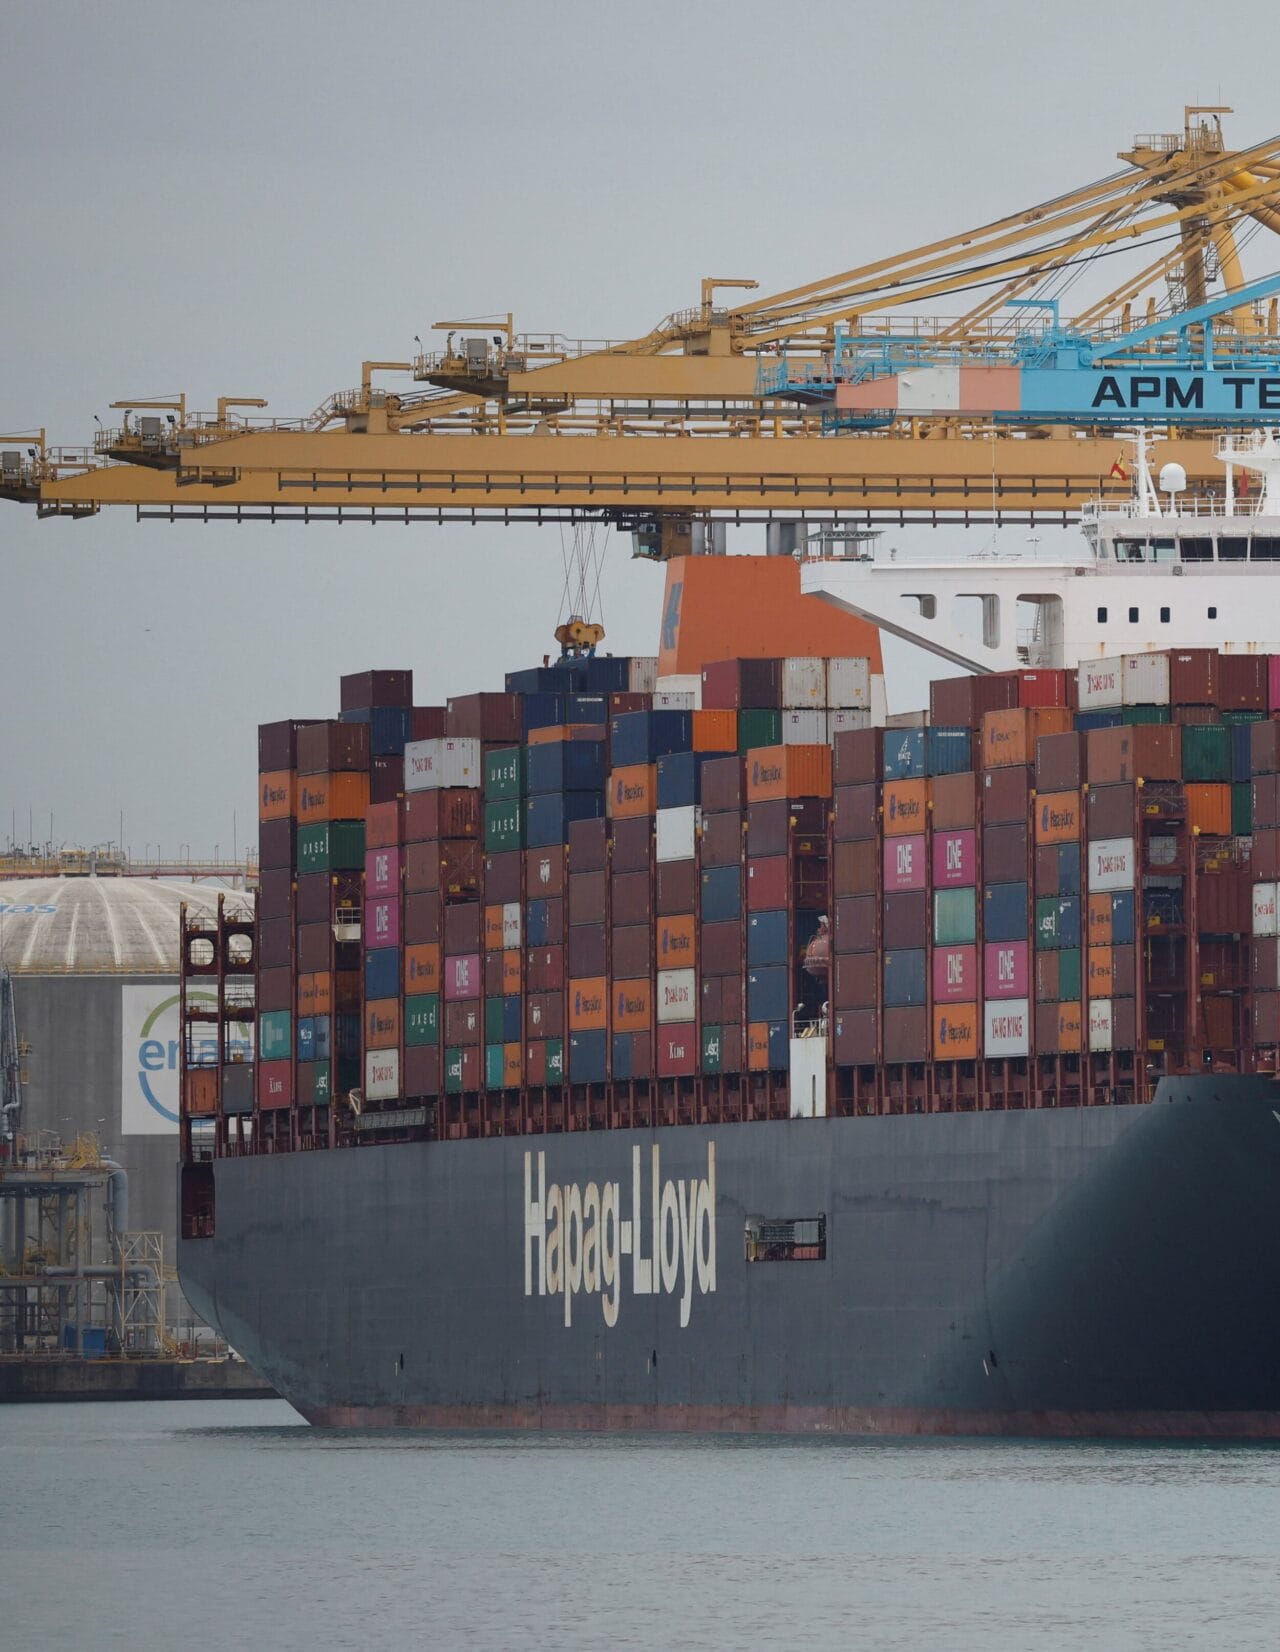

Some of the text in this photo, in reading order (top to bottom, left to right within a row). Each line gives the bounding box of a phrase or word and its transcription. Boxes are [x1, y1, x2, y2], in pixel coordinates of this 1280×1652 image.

[1091, 376, 1204, 408] APM
[376, 855, 389, 882] ONE
[897, 844, 912, 874] ONE
[946, 839, 962, 870] ONE
[376, 905, 389, 932] ONE
[455, 959, 469, 987] ONE
[947, 954, 963, 984] ONE
[998, 950, 1014, 980] ONE
[524, 1141, 716, 1328] Hapag-Lloyd
